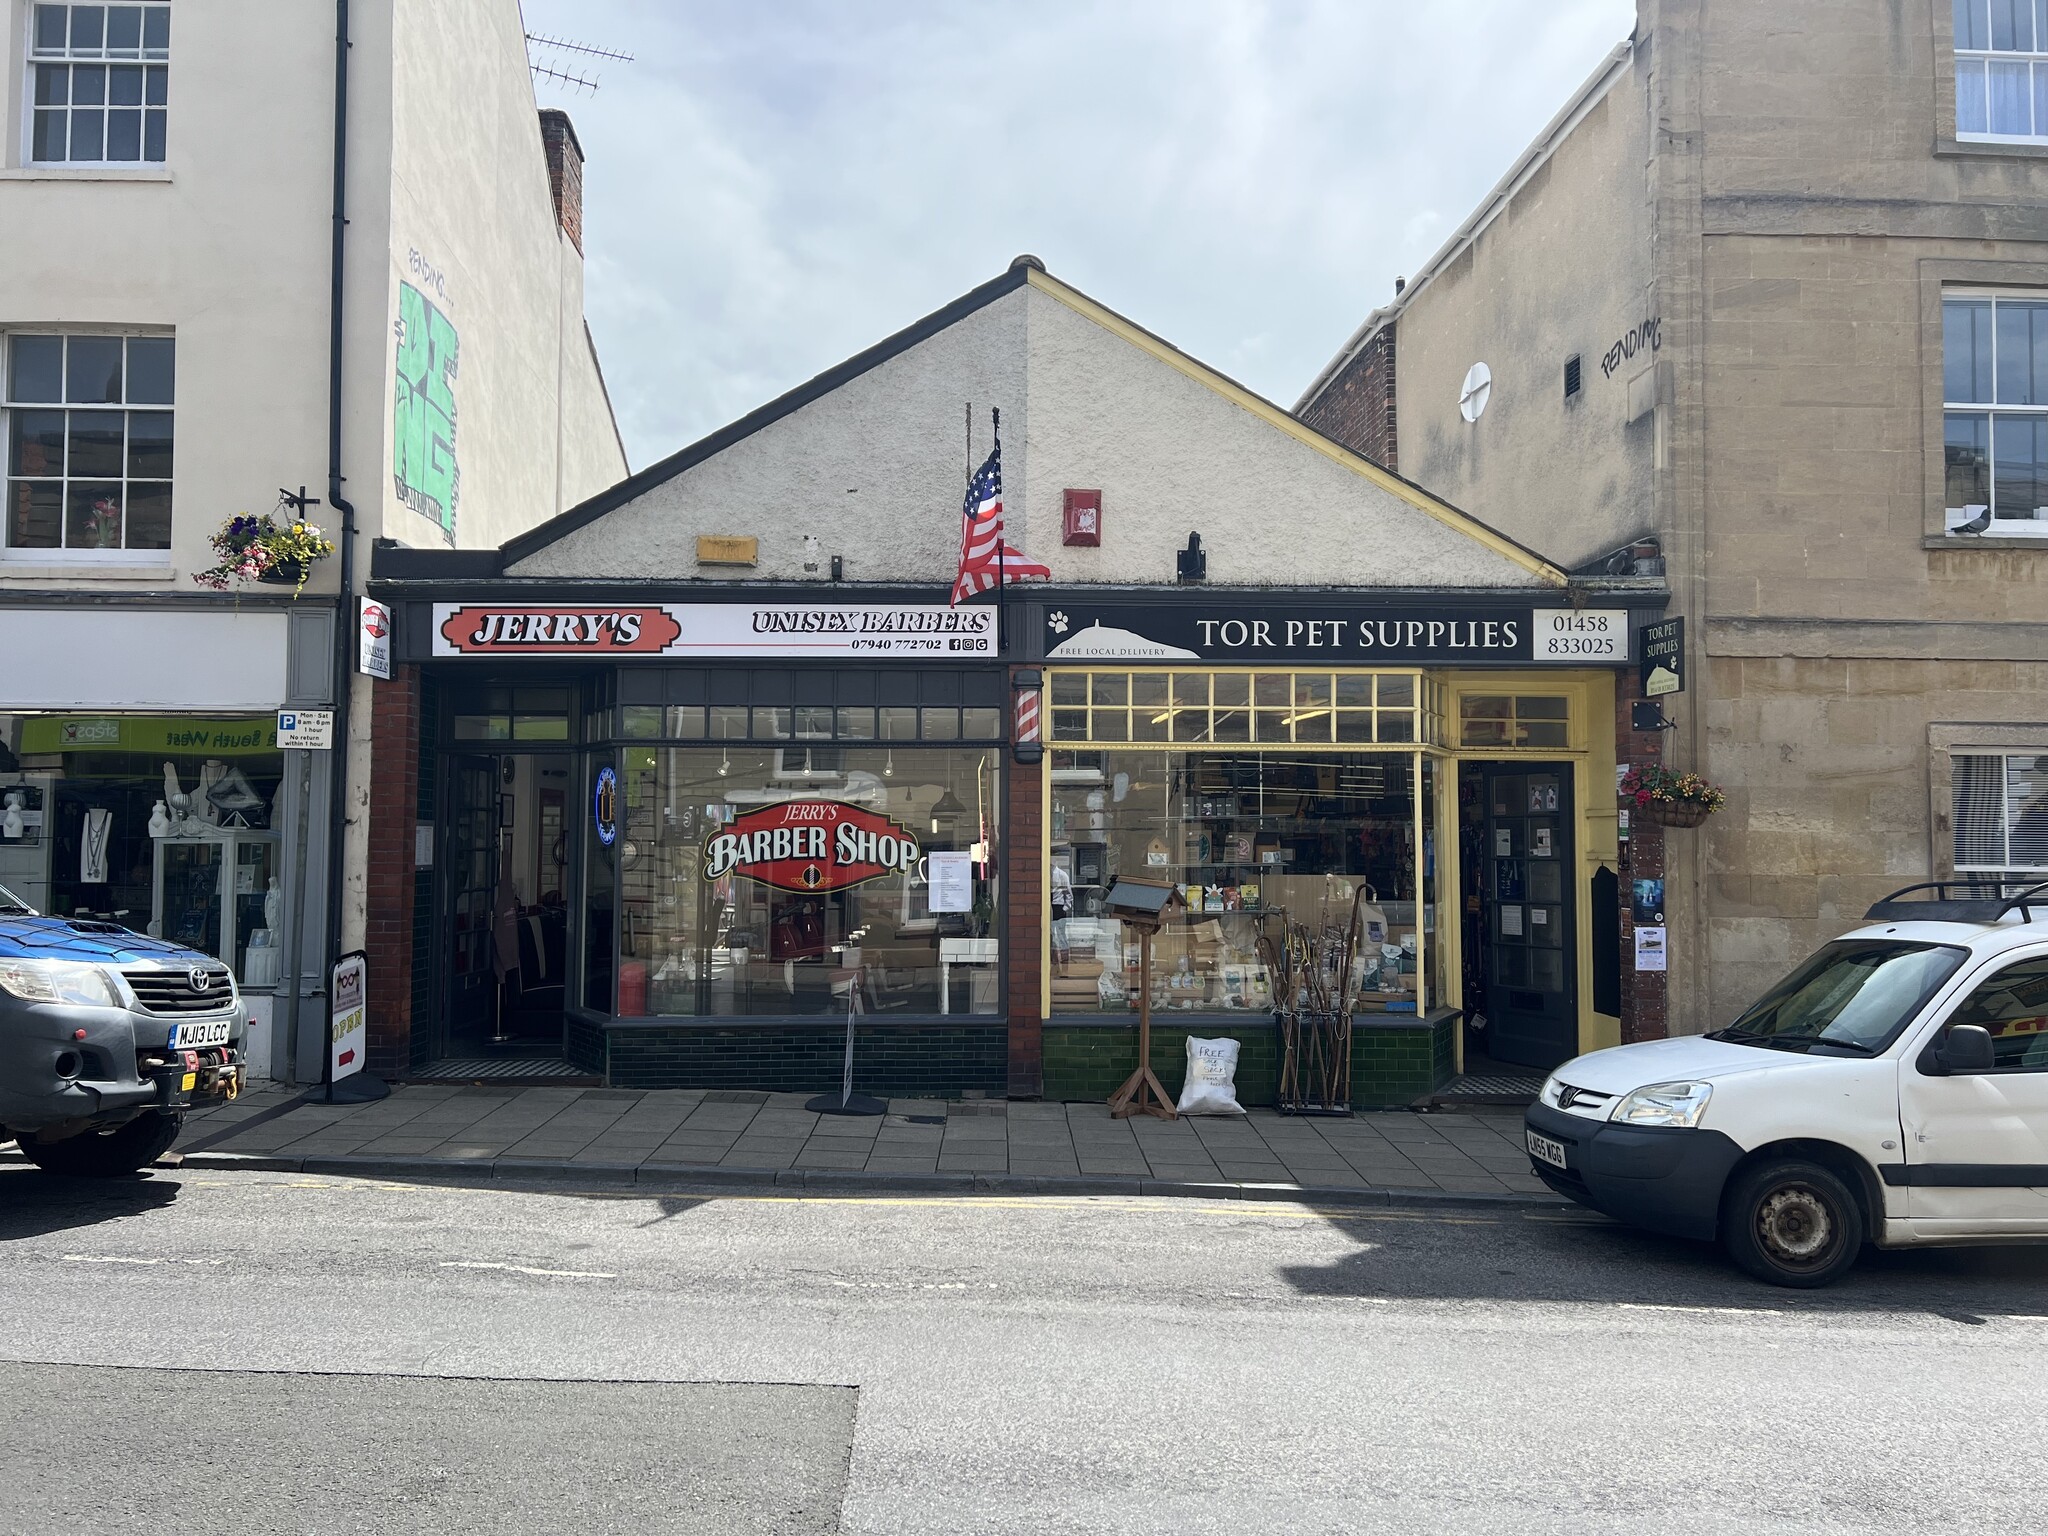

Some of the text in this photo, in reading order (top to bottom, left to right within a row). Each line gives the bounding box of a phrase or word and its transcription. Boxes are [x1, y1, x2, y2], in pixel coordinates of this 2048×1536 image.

[1601, 316, 1661, 379] PENDING
[471, 612, 643, 644] JERRY'S
[753, 611, 991, 633] UNISEX BARBERS
[1553, 616, 1608, 631] 01458
[1648, 622, 1677, 641] TOR PET
[1197, 620, 1518, 648] TOR PET SUPPLIES
[852, 639, 941, 650] 07940 772702
[1120, 648, 1167, 656] DELIVERY
[1548, 638, 1614, 654] 833025
[1647, 639, 1679, 658] SUPPLIES
[283, 716, 294, 728] P
[781, 804, 839, 824] JERRY'S
[707, 822, 919, 878] BARBER SHOP
[180, 1024, 227, 1045] MJ13 LCC
[332, 1008, 363, 1043] OPEN
[1199, 1046, 1225, 1057] FREE
[1546, 1141, 1562, 1164] WGG
